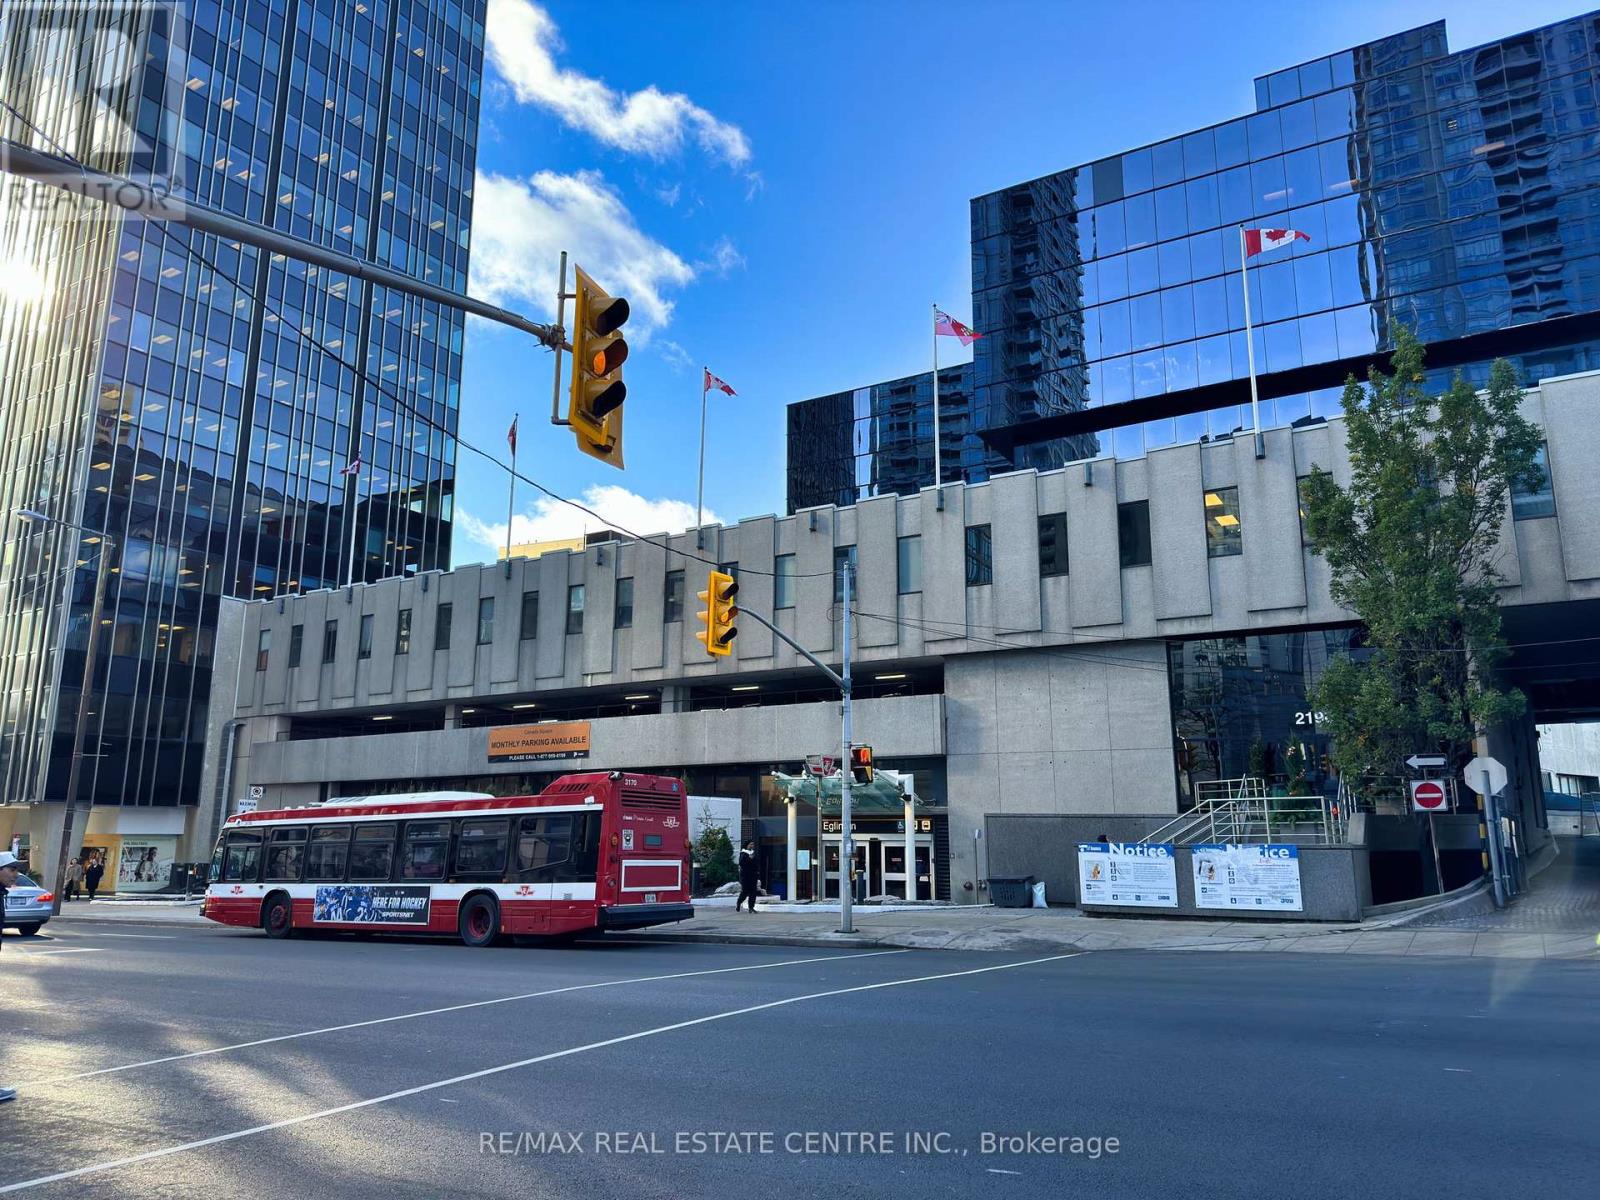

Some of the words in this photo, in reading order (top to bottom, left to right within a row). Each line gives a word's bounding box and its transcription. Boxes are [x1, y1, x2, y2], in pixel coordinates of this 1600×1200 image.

[491, 740, 520, 749] MONTHLY
[521, 738, 550, 747] PARKING
[550, 735, 586, 745] AVAILABLE
[1109, 842, 1167, 858] Notice
[372, 896, 389, 908] HERE
[388, 897, 401, 909] FOR
[401, 897, 428, 910] HOCKEY
